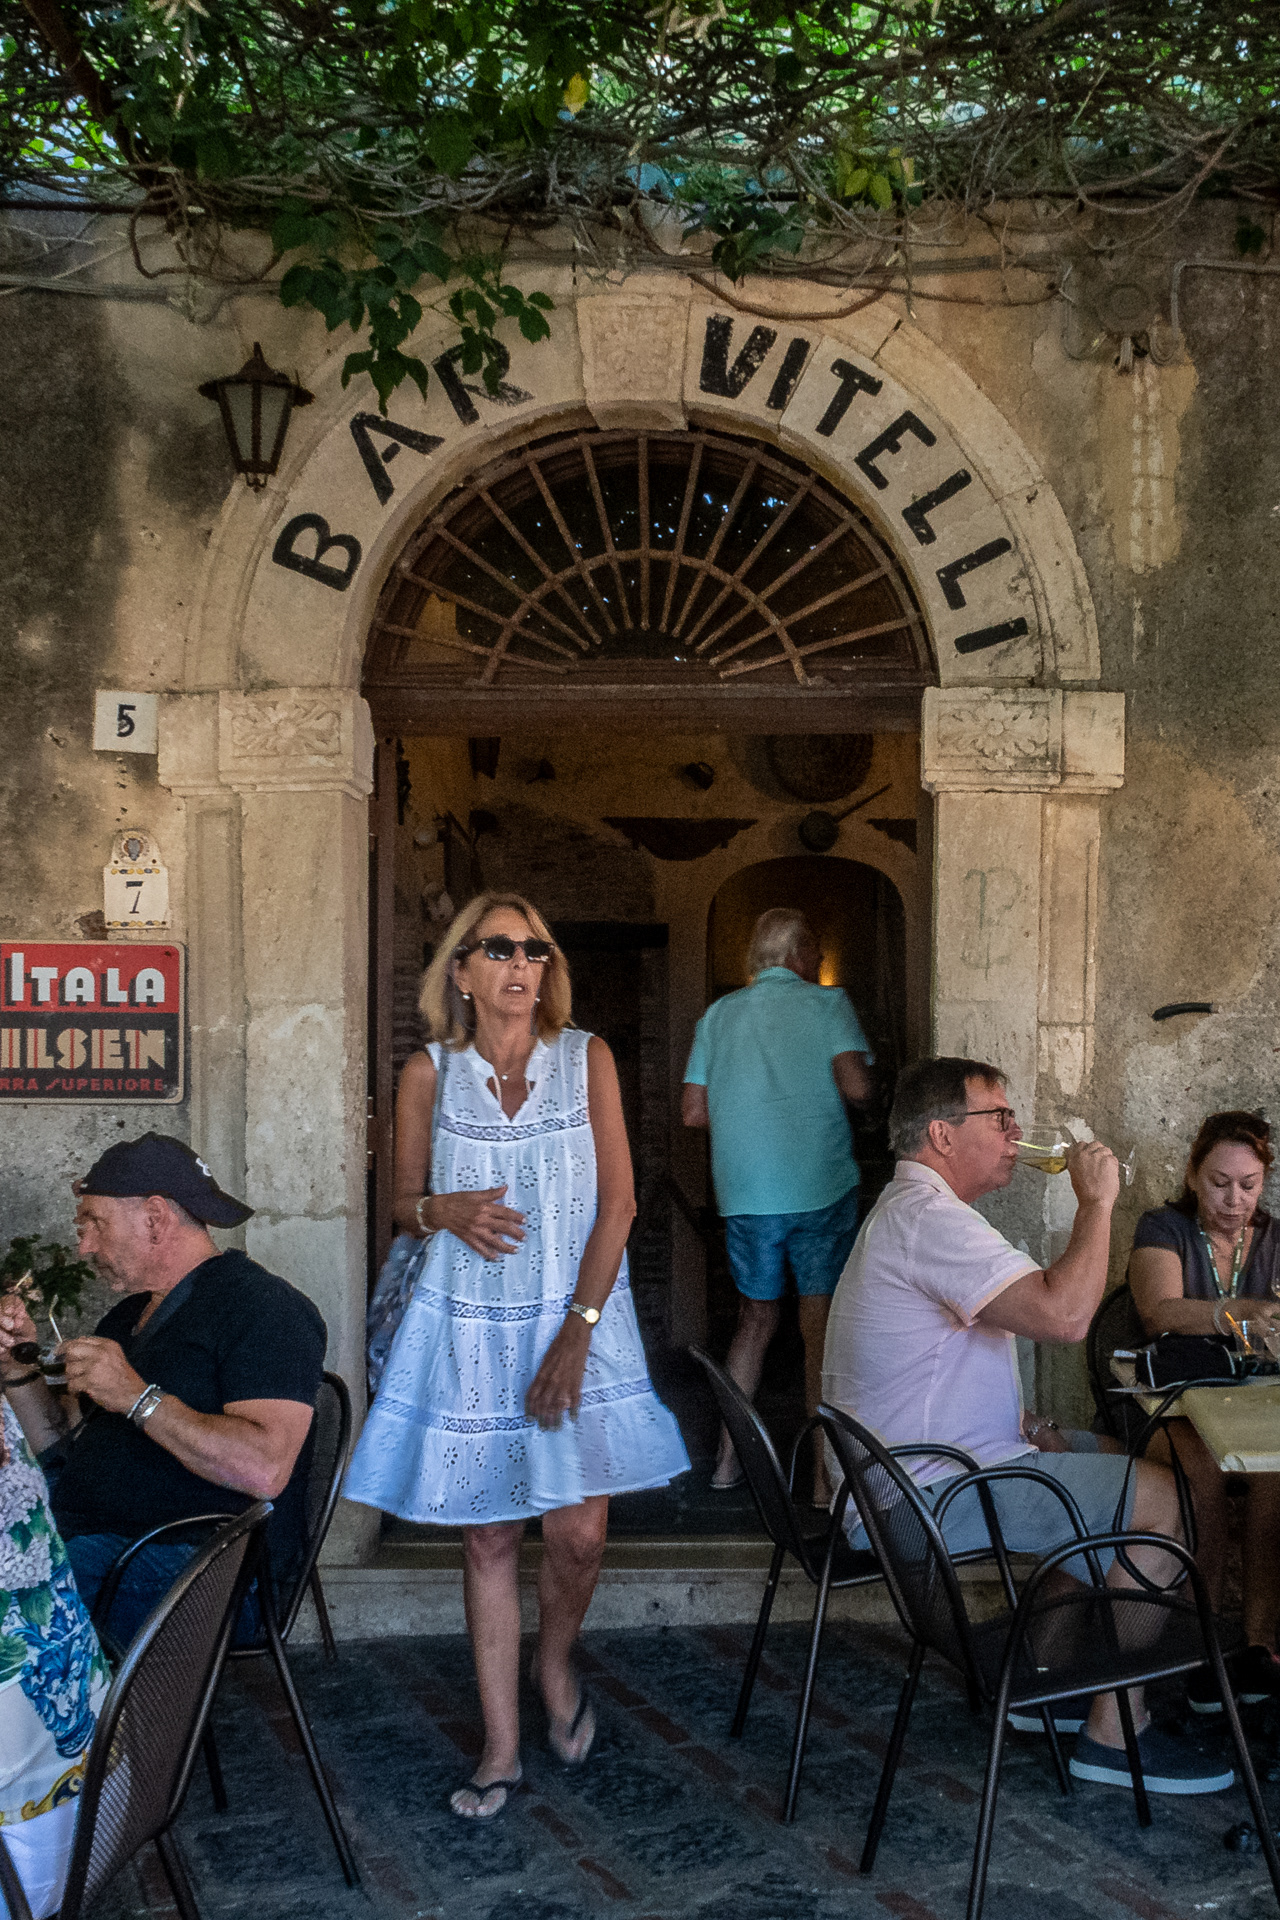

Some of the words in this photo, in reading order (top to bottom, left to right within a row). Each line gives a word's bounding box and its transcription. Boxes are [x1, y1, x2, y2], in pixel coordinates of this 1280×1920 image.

[272, 333, 535, 591] BAR
[699, 312, 1029, 654] VITELLI
[115, 704, 137, 738] 5
[125, 880, 144, 914] 7
[5, 952, 165, 1007] ITALA
[45, 1078, 164, 1092] SUPERIORE
